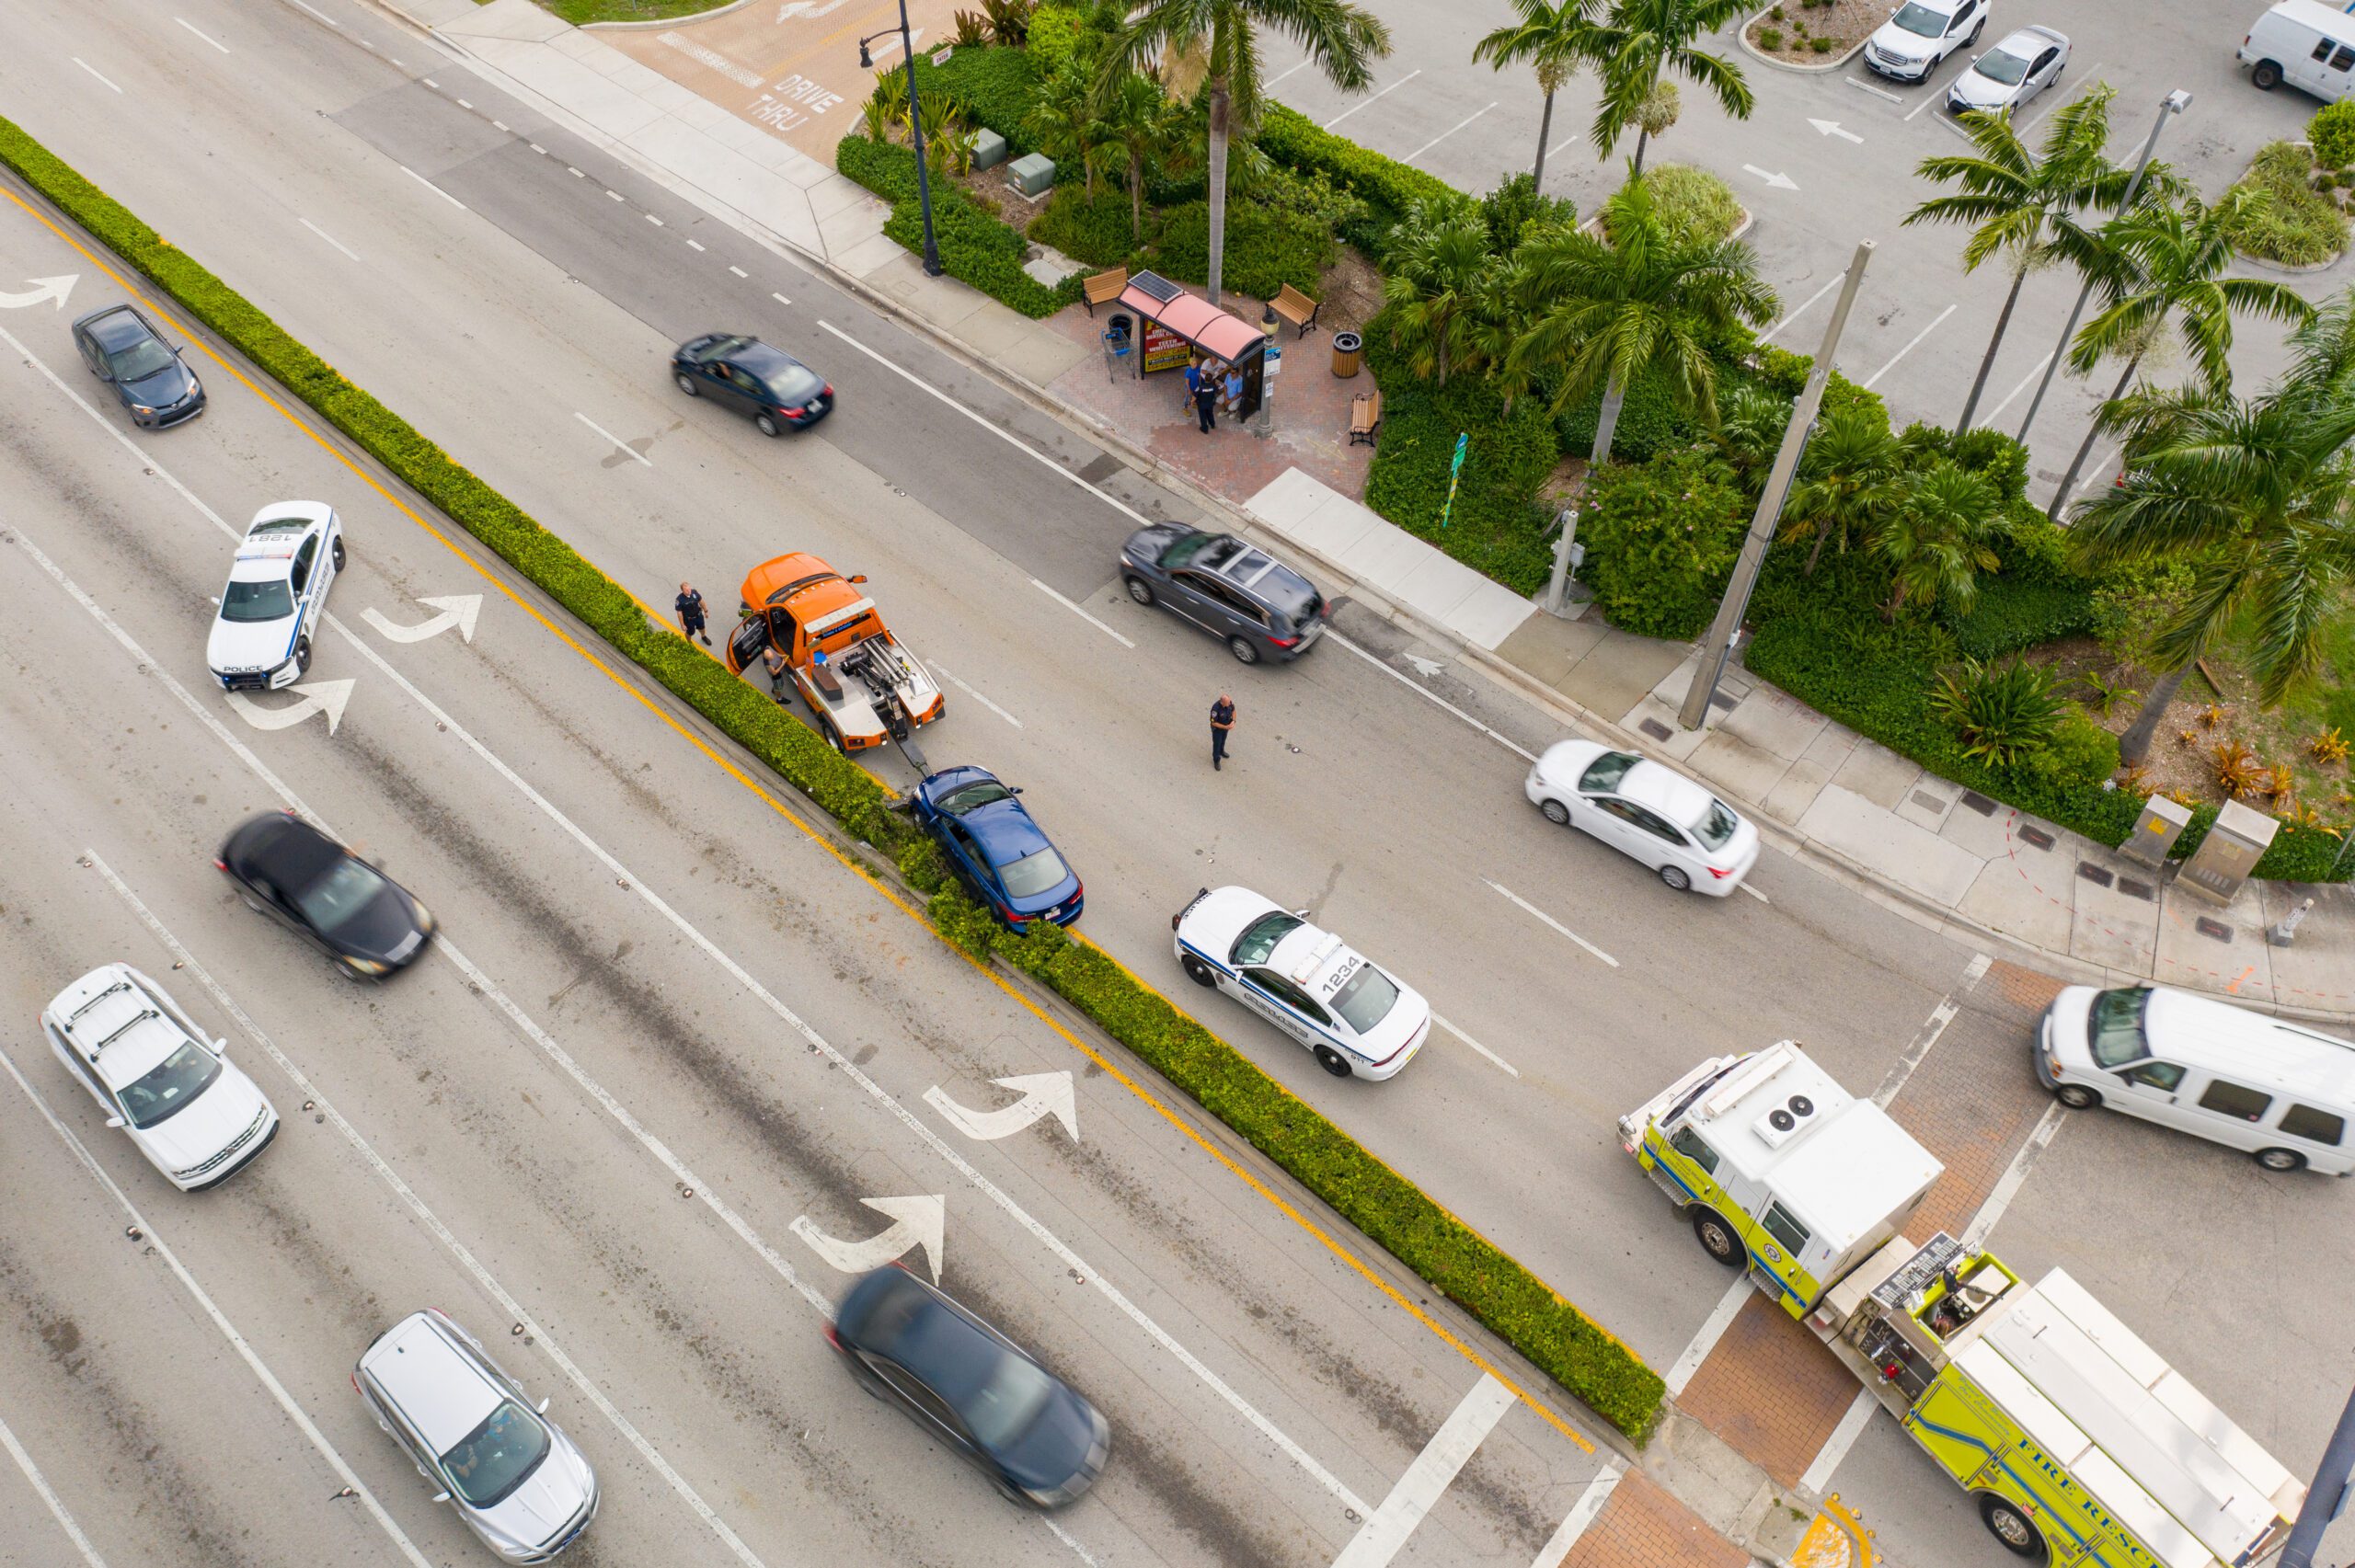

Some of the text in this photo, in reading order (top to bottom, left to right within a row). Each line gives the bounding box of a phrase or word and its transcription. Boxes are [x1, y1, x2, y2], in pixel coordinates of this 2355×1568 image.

[774, 74, 844, 114] DRIVE
[745, 94, 809, 132] THRU
[1149, 341, 1187, 352] WHITENING
[1158, 338, 1178, 347] TEETH
[1147, 351, 1170, 360] DENTAL
[248, 534, 292, 544] 1281
[1322, 956, 1361, 995] 1234
[1350, 1054, 1365, 1064] 911
[2018, 1438, 2159, 1568] FIRE RESC
